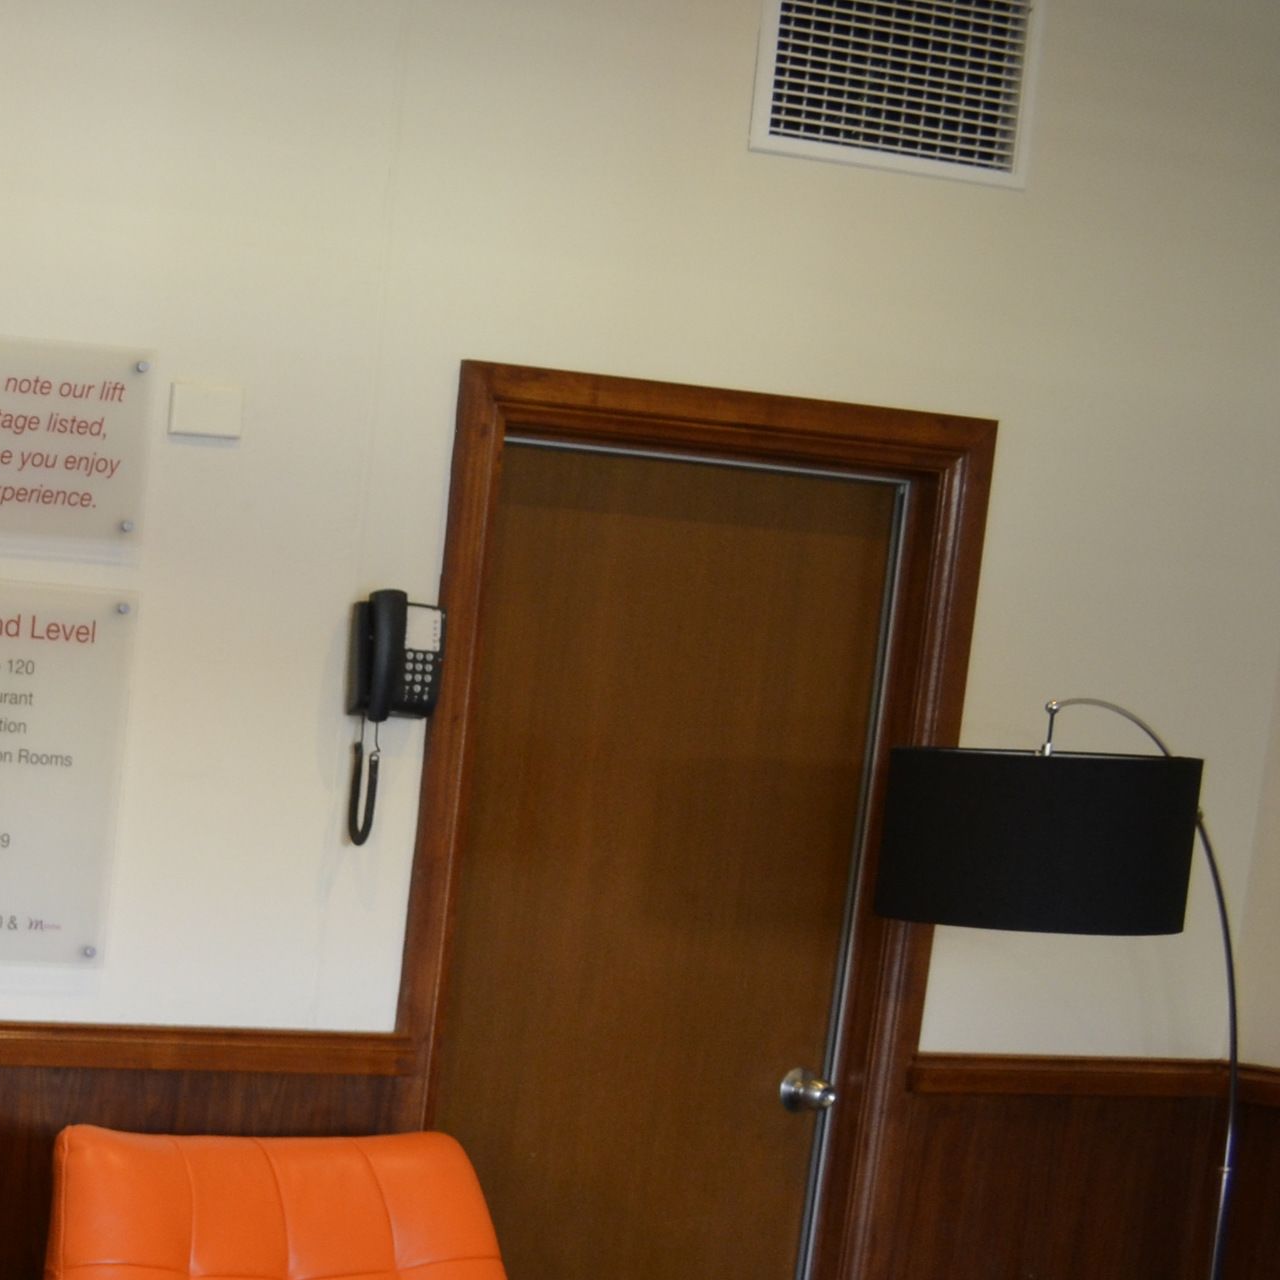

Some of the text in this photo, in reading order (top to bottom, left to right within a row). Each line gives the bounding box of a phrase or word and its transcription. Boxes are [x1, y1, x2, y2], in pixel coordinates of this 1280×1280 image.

[4, 376, 52, 396] note
[58, 382, 95, 399] our
[99, 381, 126, 403] lift
[46, 412, 107, 440] listed,
[17, 451, 58, 471] you
[64, 452, 121, 479] enjoy
[30, 614, 97, 644] Level
[8, 658, 35, 676] 120
[17, 748, 73, 767] Rooms
[7, 915, 18, 930] &
